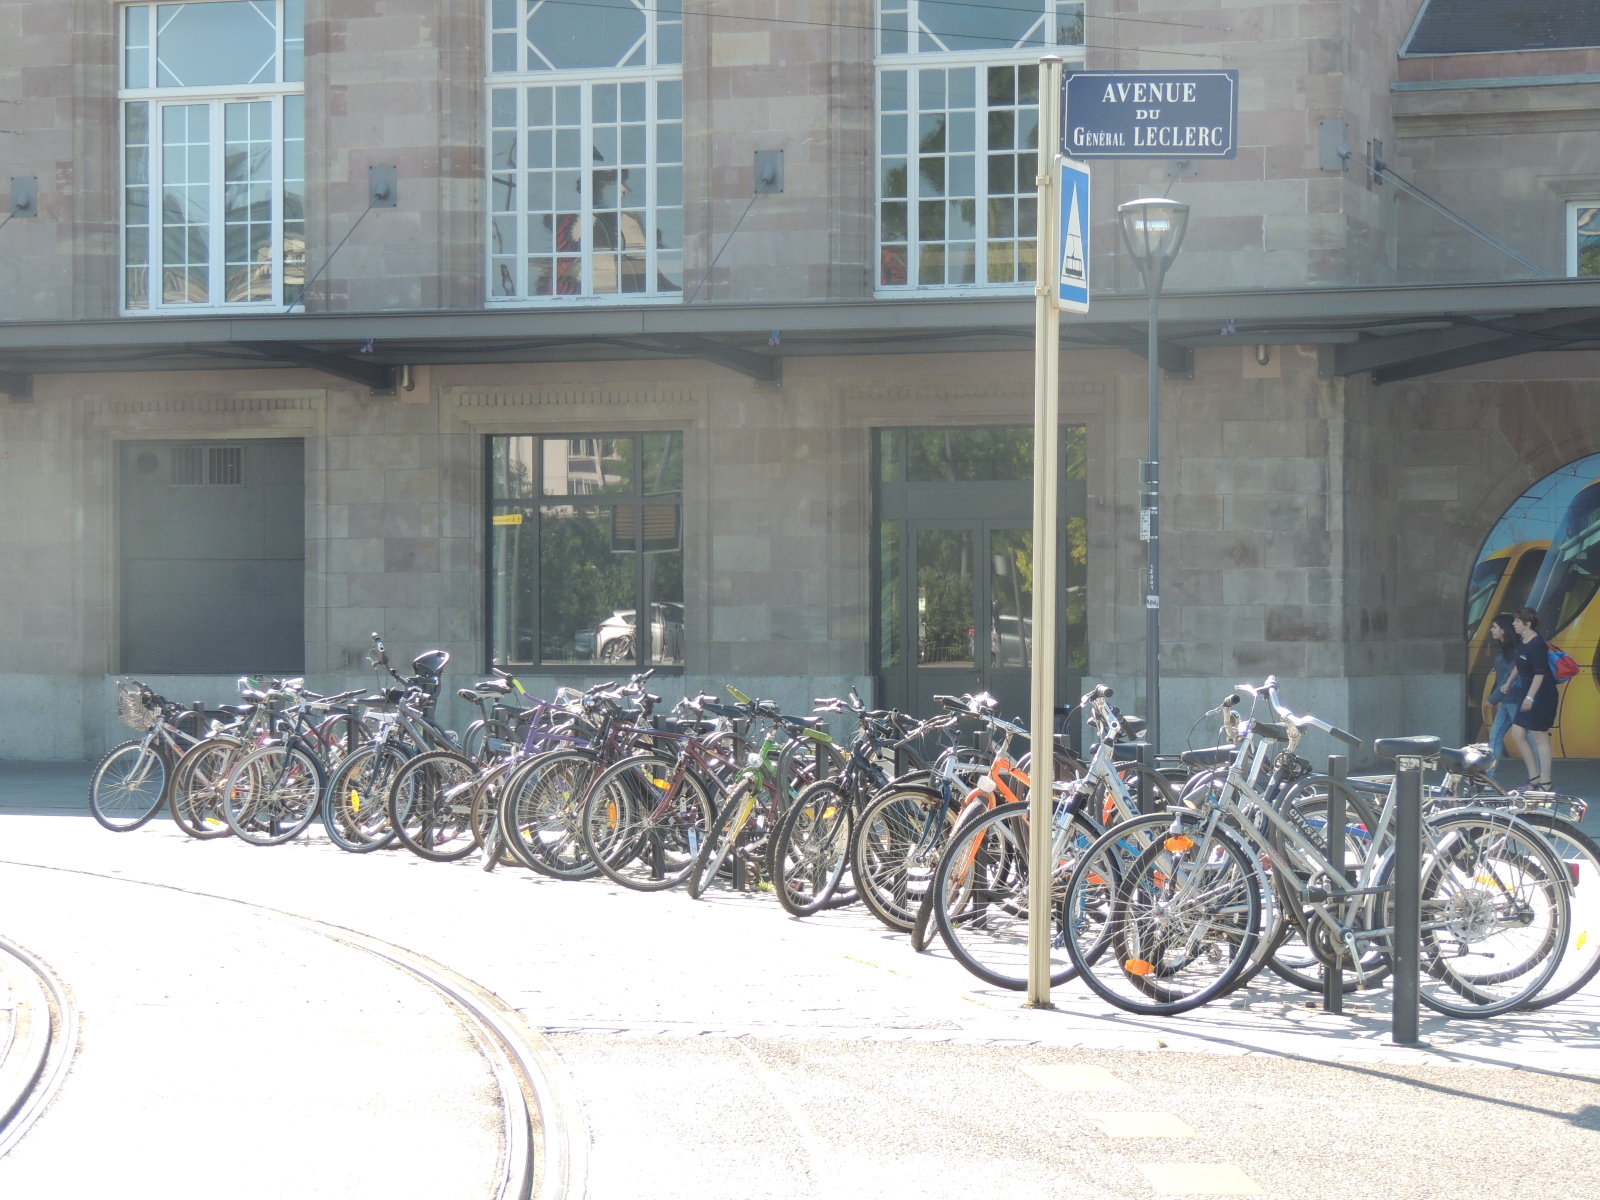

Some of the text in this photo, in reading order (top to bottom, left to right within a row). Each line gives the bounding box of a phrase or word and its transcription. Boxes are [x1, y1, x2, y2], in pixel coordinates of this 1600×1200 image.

[1102, 82, 1196, 103] AVENUE
[1135, 109, 1161, 120] DU
[1073, 126, 1223, 147] GÉNÉRAL LECLERC
